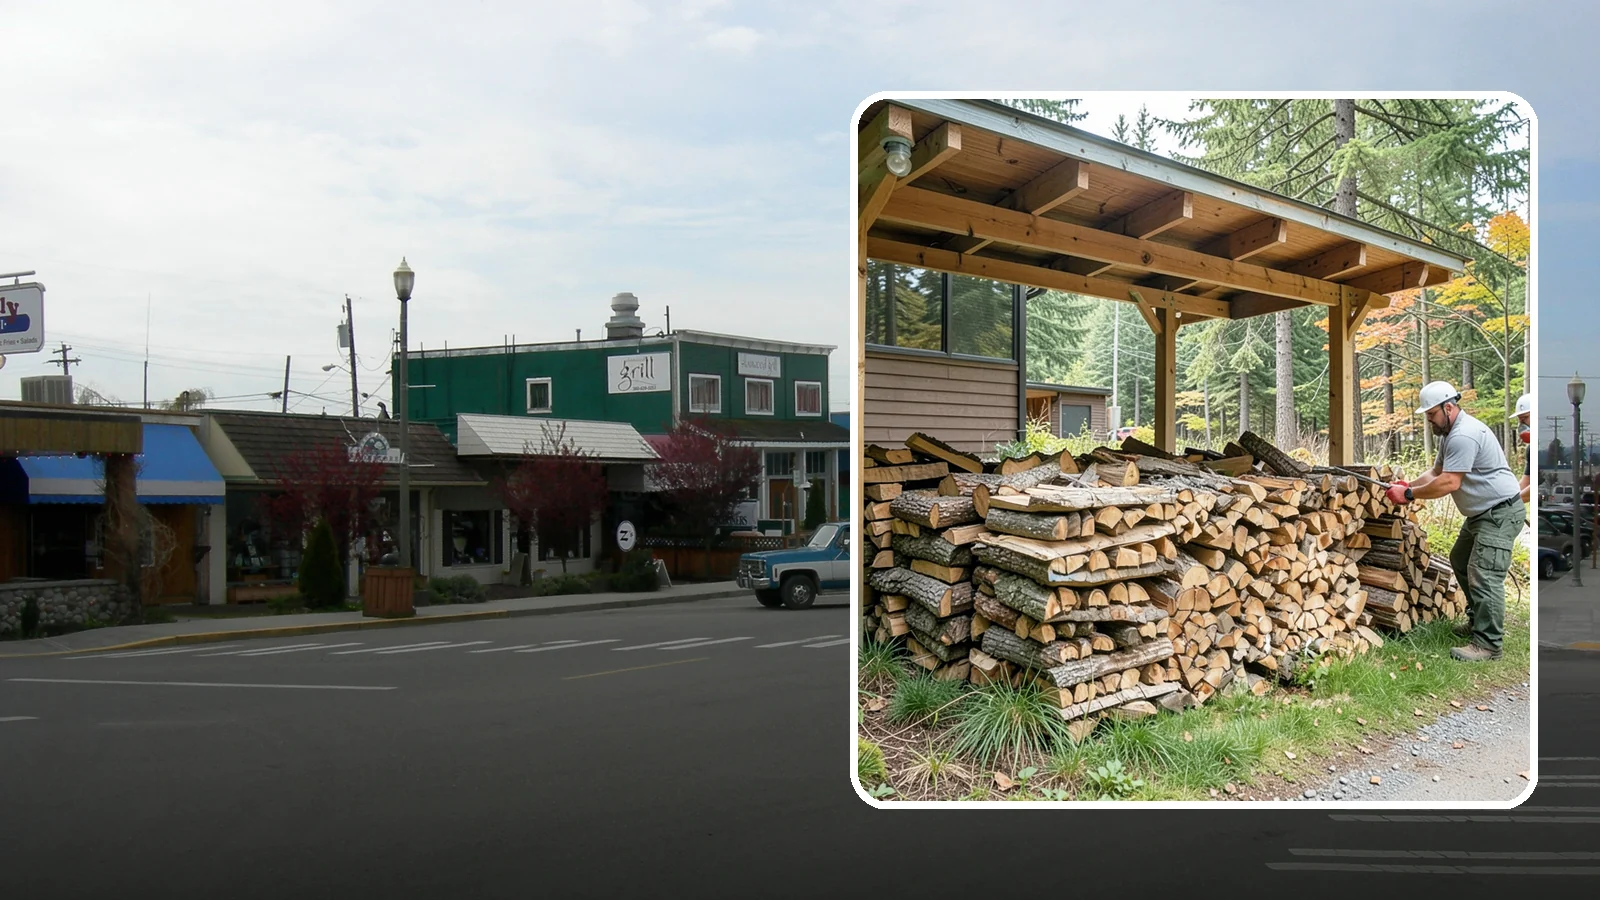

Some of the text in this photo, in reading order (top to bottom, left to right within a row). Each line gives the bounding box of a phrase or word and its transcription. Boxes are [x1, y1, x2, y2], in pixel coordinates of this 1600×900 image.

[0, 297, 19, 324] ly
[20, 337, 37, 345] Salads
[618, 356, 655, 391] grill
